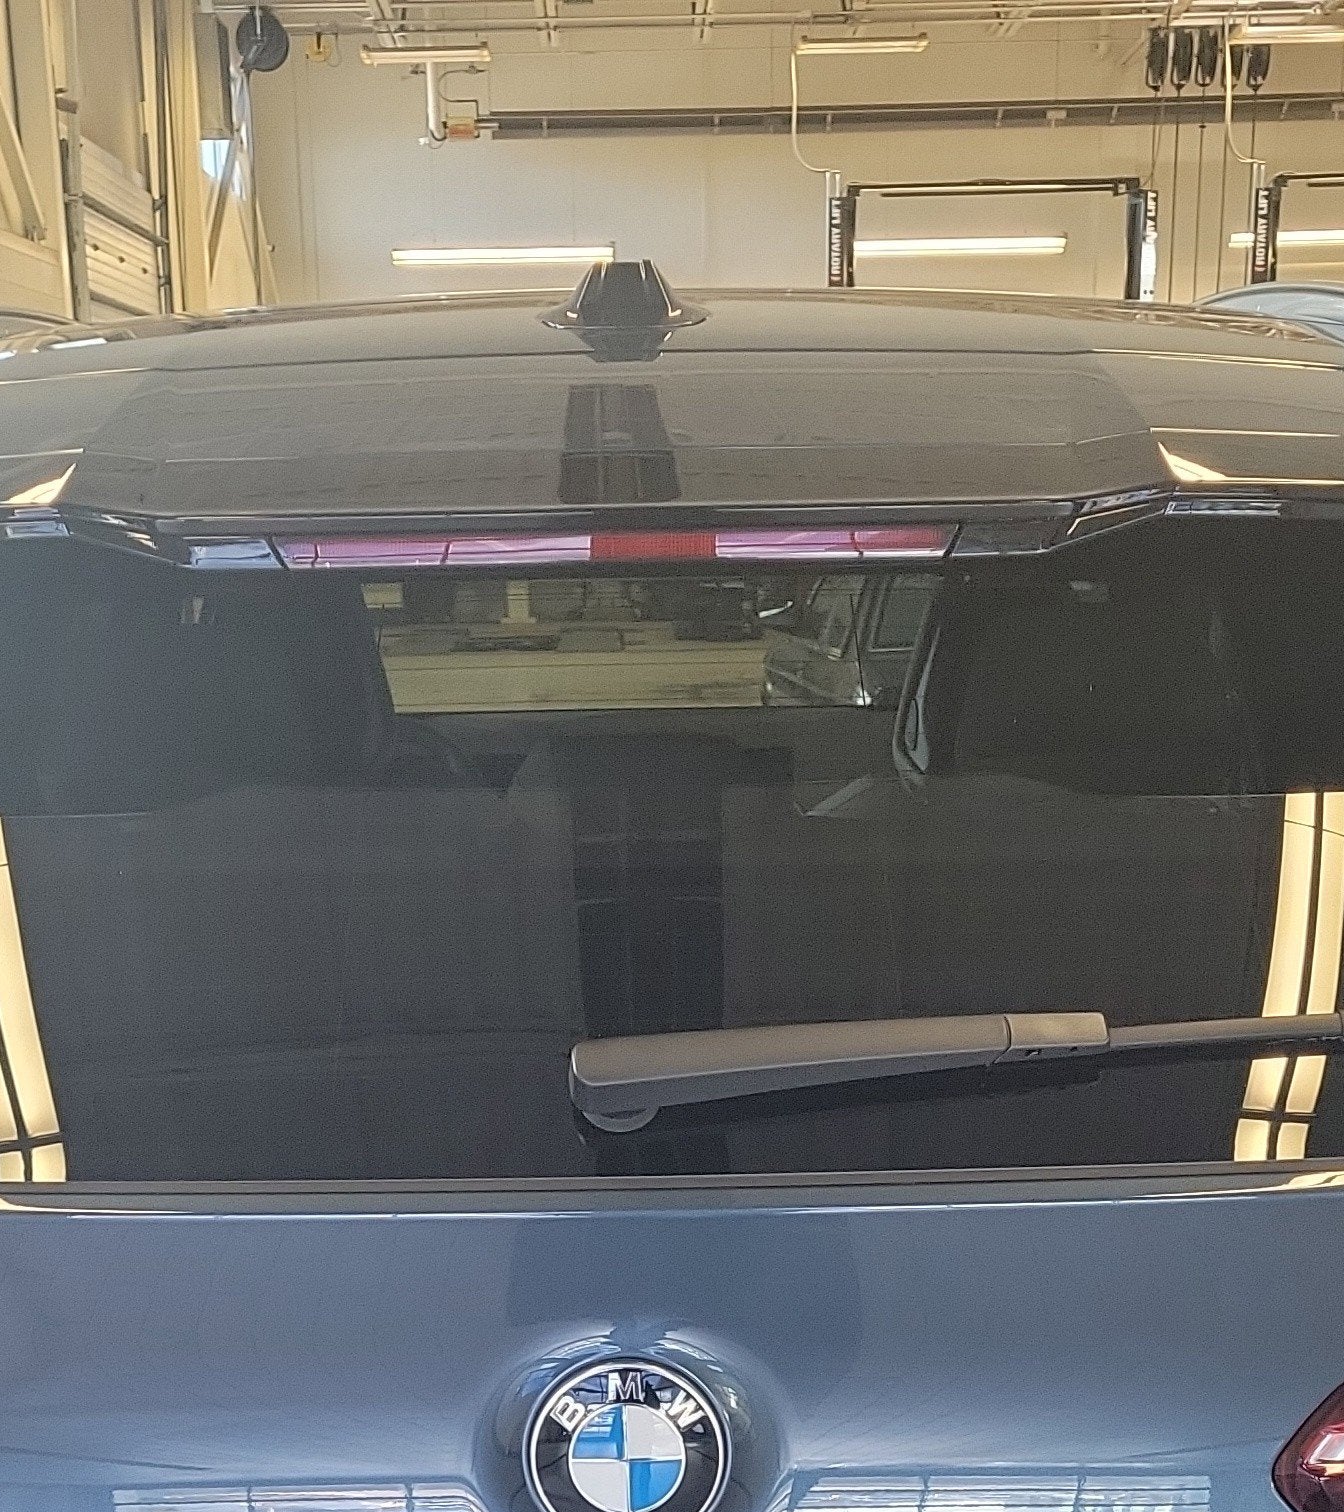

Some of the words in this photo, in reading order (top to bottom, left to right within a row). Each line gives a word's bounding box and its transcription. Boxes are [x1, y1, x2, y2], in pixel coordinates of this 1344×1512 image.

[831, 199, 841, 225] LIFT
[1146, 190, 1157, 217] LIFT
[1257, 189, 1270, 215] LIFT
[1255, 217, 1269, 266] ROTARY
[549, 1371, 707, 1434] BMW
